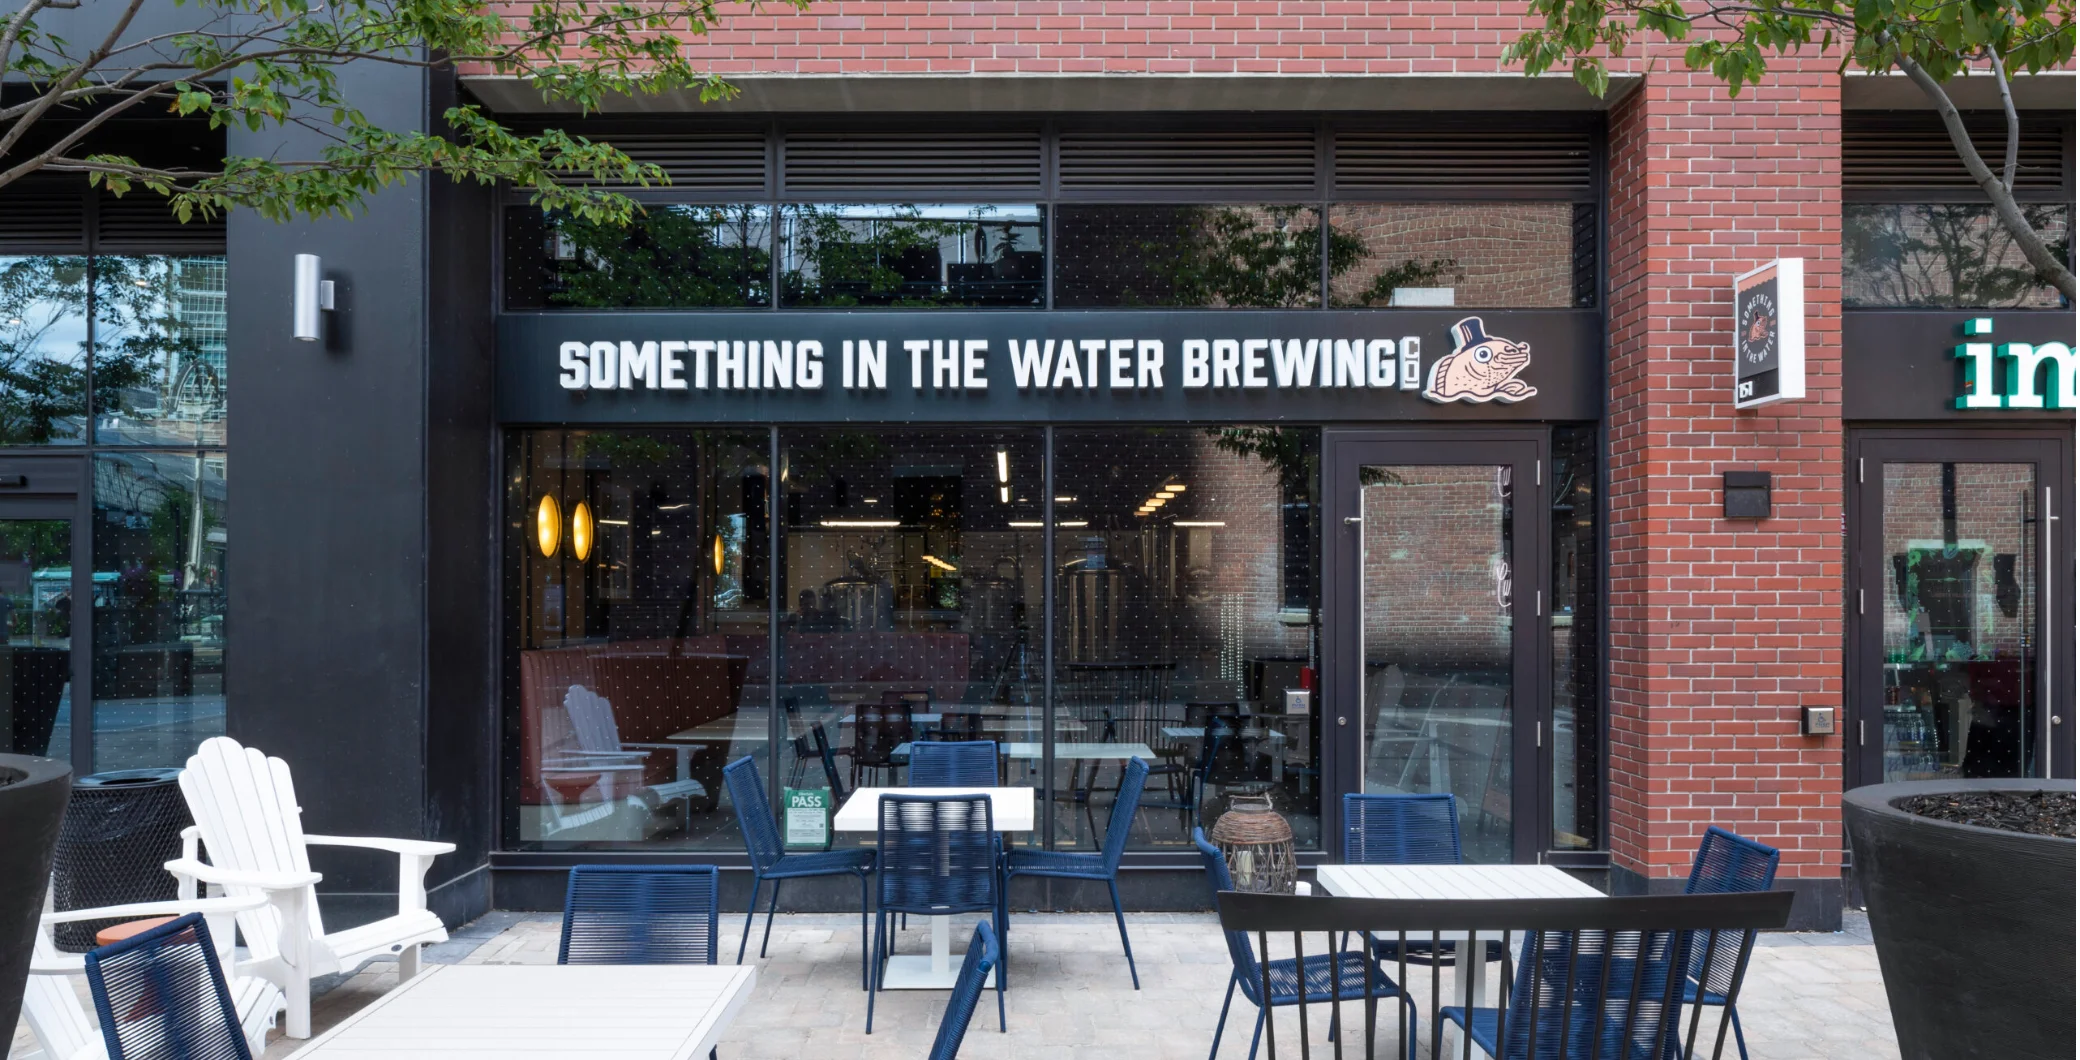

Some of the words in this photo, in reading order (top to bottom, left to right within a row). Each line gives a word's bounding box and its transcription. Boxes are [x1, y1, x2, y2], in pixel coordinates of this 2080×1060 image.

[1742, 294, 1775, 326] SOMETHING
[1758, 331, 1776, 362] WATER
[559, 340, 824, 390] SOMETHING
[842, 340, 887, 389] IN
[904, 340, 988, 389] THE
[1008, 339, 1163, 389] WATER
[1182, 338, 1395, 390] BREWING
[792, 796, 822, 807] PASS
